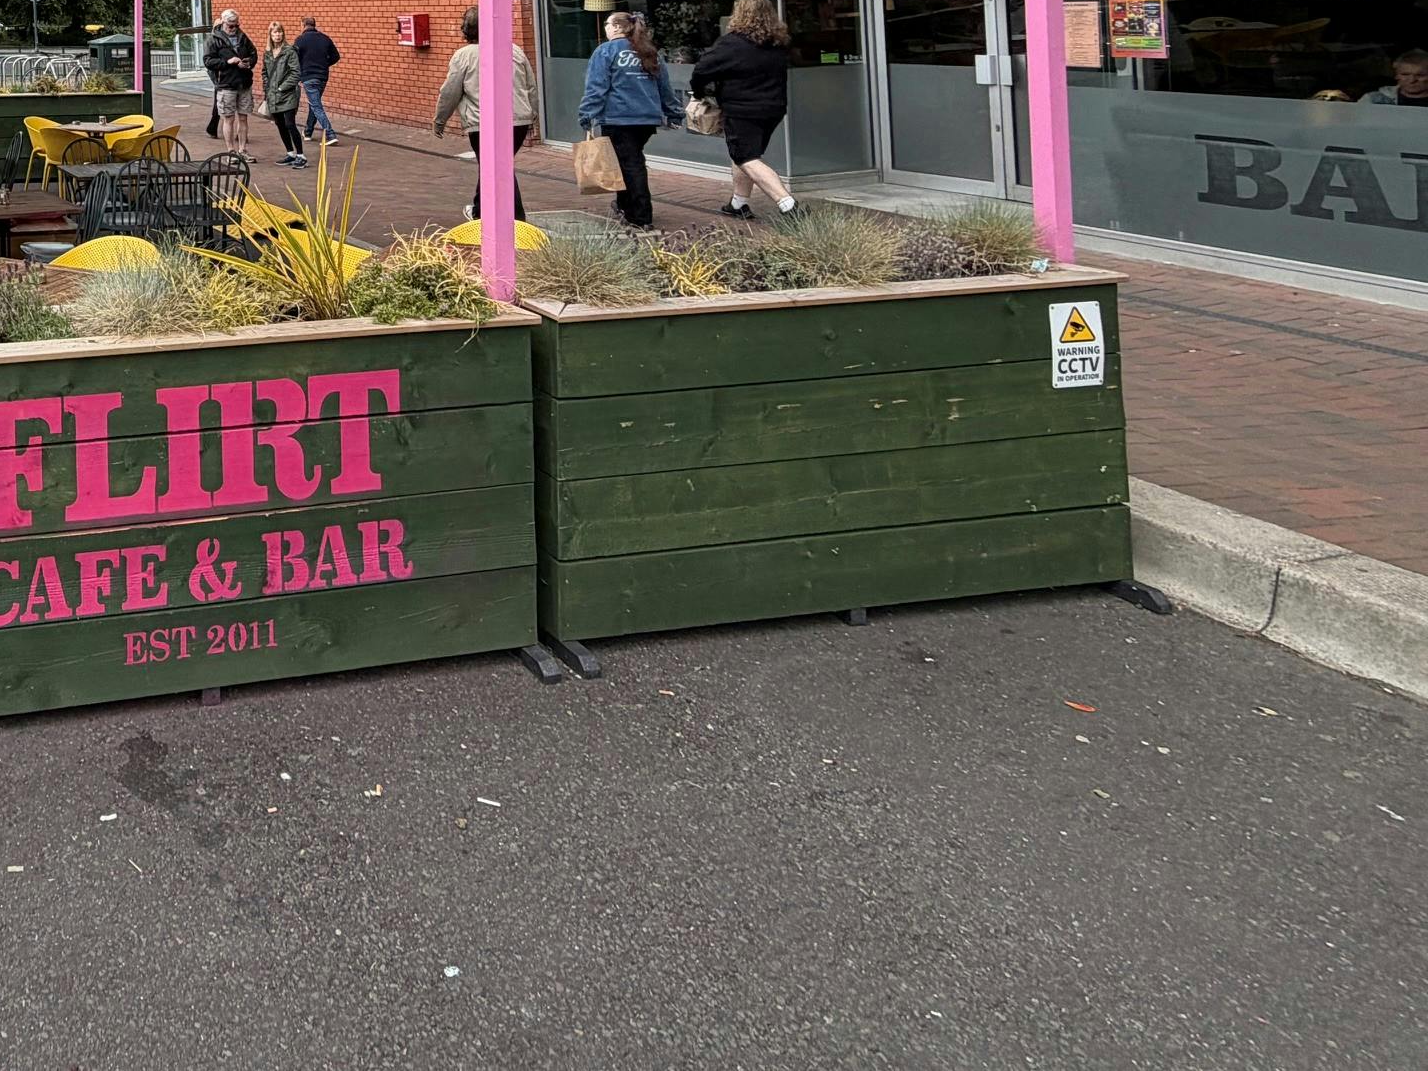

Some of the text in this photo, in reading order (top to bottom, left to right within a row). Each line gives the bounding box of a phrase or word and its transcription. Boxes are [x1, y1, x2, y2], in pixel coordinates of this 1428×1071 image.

[1057, 345, 1100, 357] WARNING
[1057, 356, 1100, 374] CCTV
[1065, 373, 1100, 382] OPERATION
[188, 537, 243, 602] &
[261, 518, 414, 595] BAR
[123, 619, 278, 666] EST 2011
